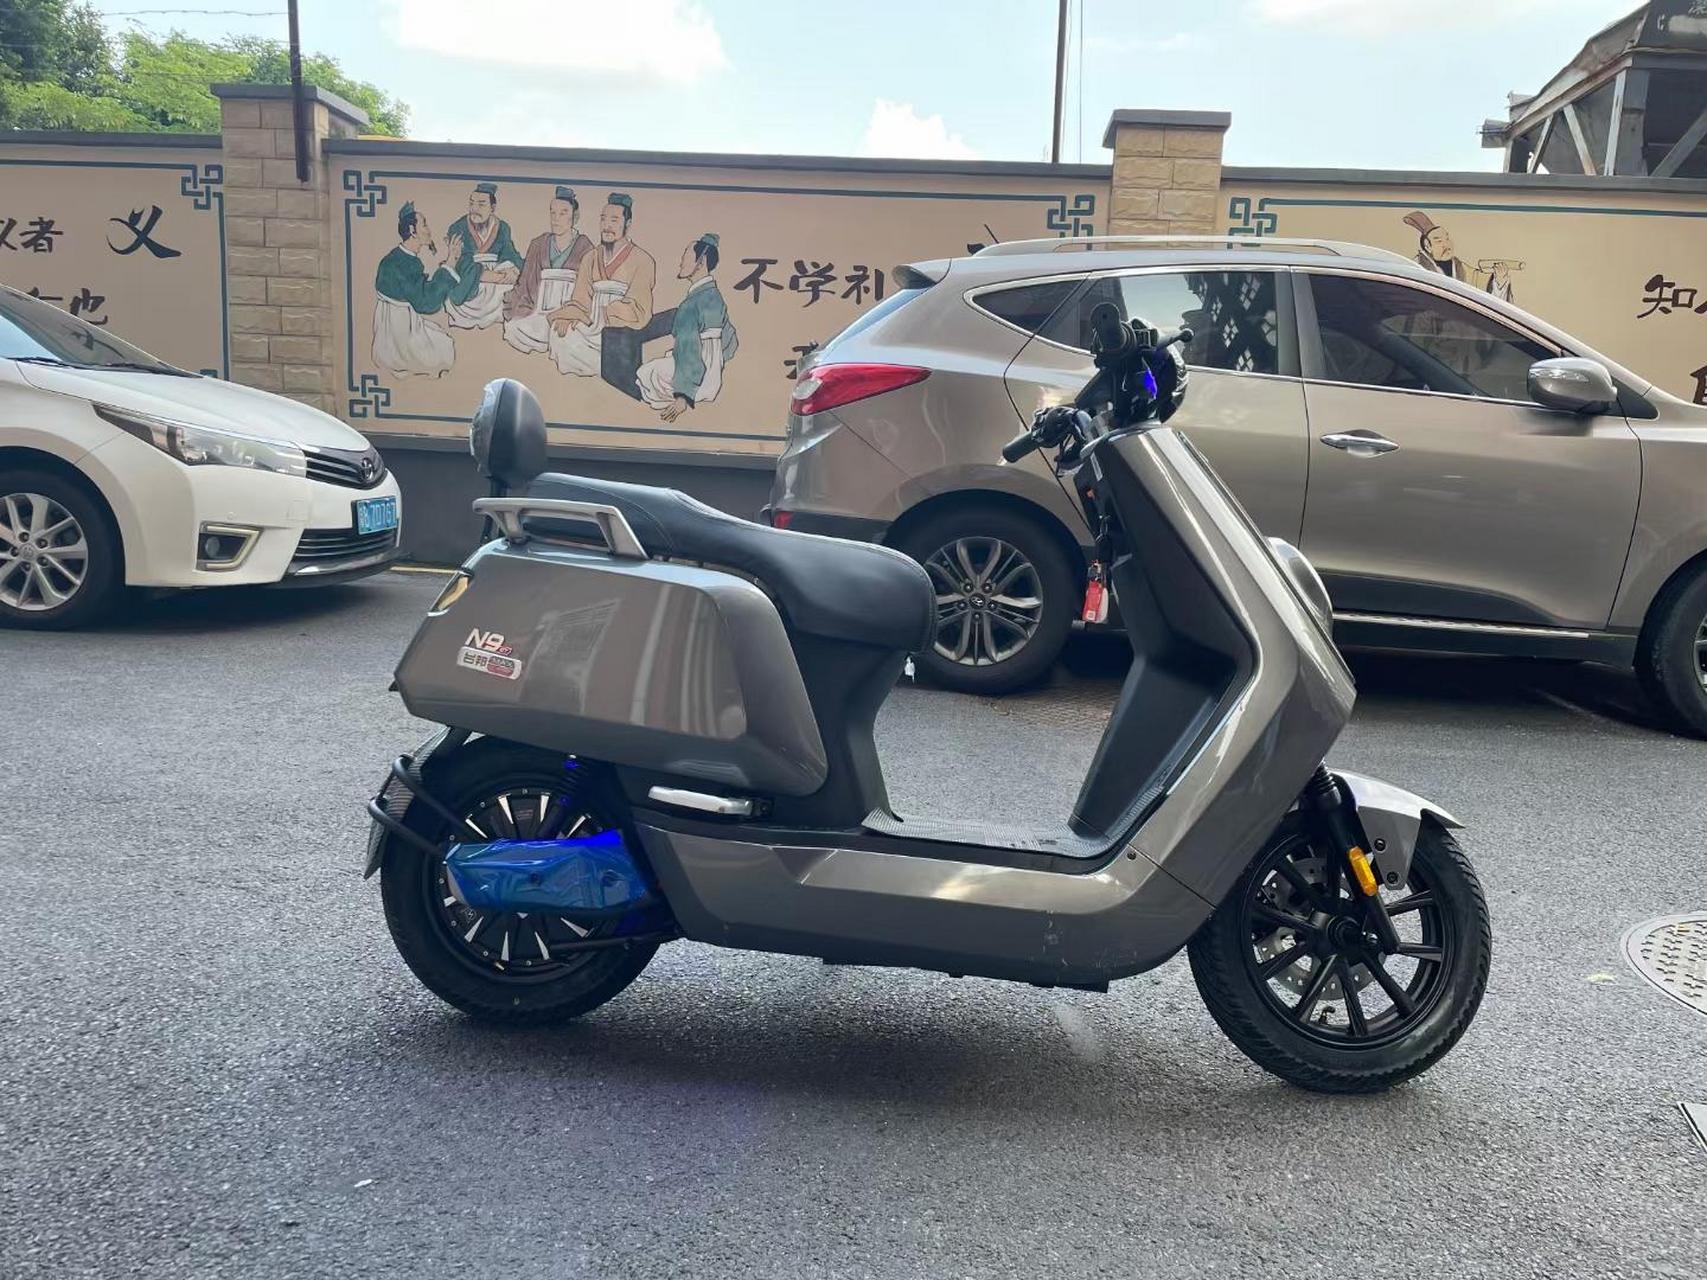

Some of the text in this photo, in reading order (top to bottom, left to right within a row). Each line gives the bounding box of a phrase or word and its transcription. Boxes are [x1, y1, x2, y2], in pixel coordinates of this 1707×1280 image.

[106, 205, 182, 259] 义
[733, 258, 885, 308] 不学礼
[464, 627, 505, 652] N9
